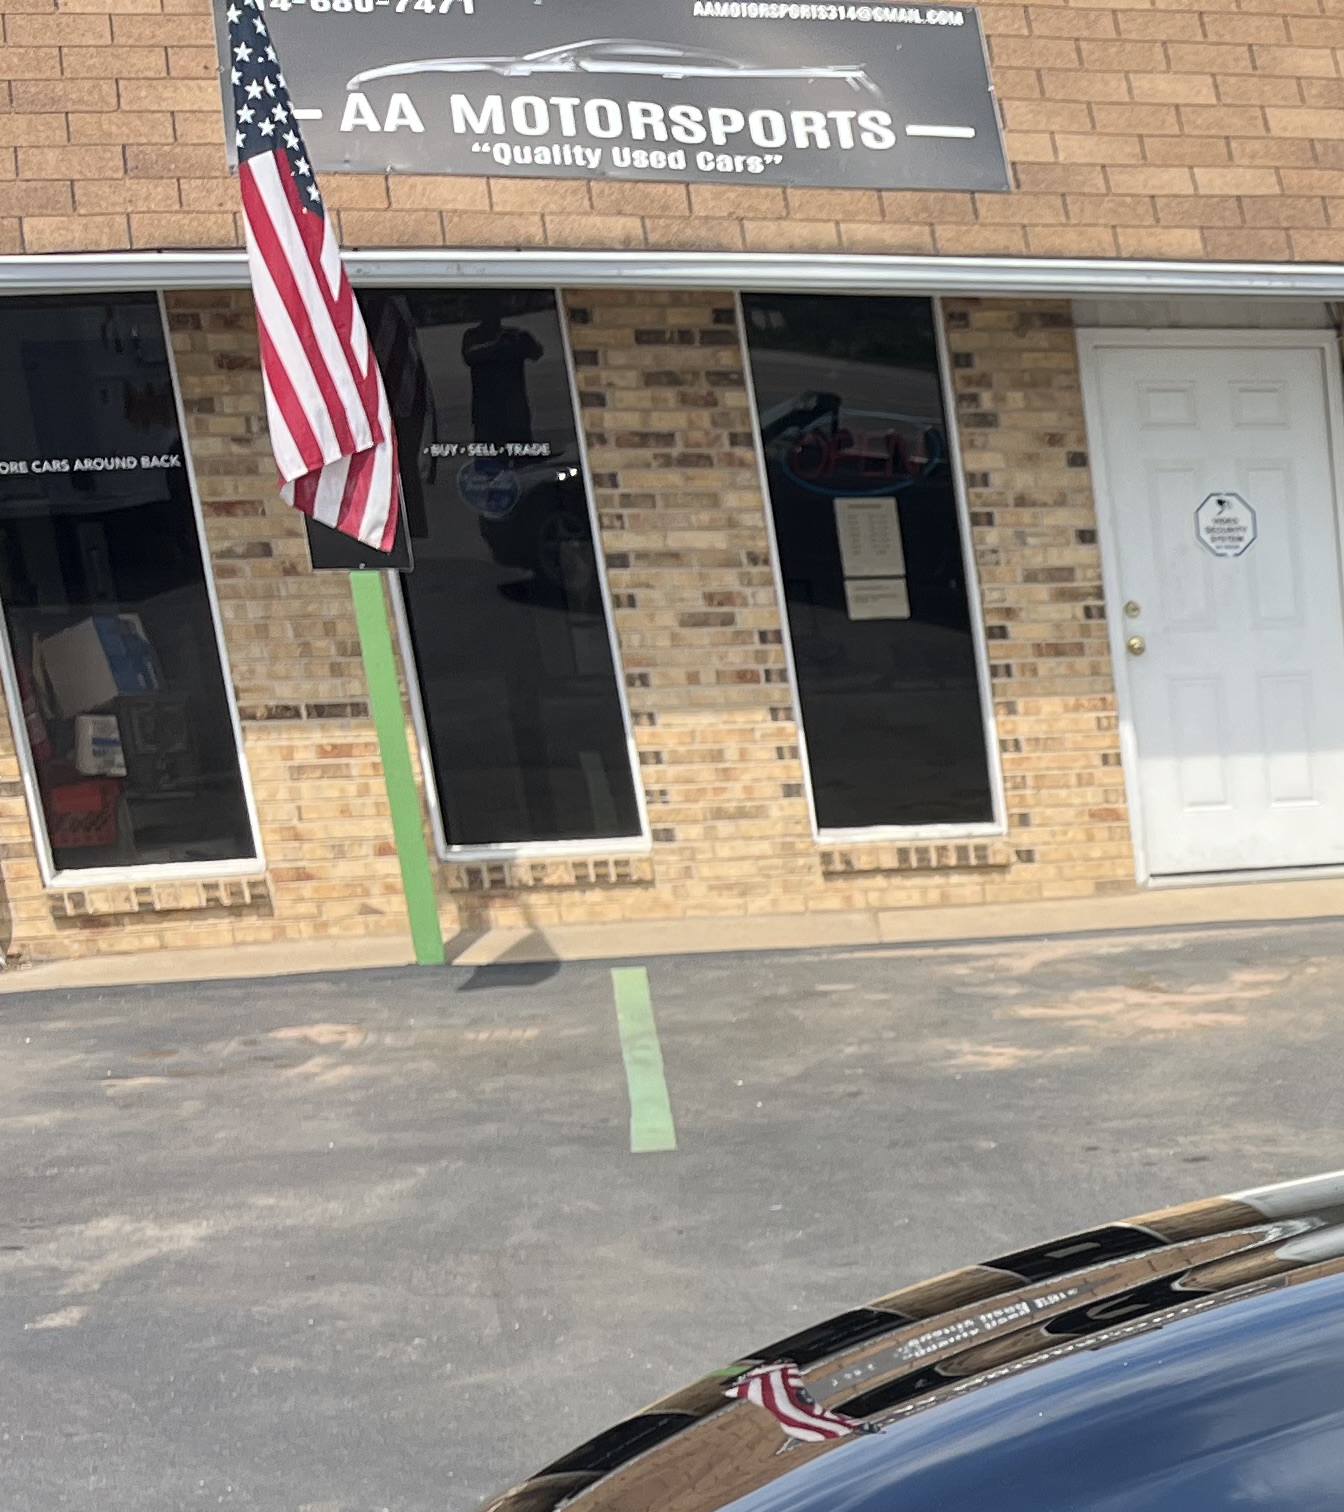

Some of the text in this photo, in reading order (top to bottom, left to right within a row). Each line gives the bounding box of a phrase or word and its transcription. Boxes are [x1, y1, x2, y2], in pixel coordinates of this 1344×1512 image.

[340, 92, 896, 150] AA MOTORSPORTS
[611, 147, 687, 170] Used
[430, 443, 550, 457] BUY SELL TRADE
[0, 454, 182, 475] ORE CARS AROUND BACK
